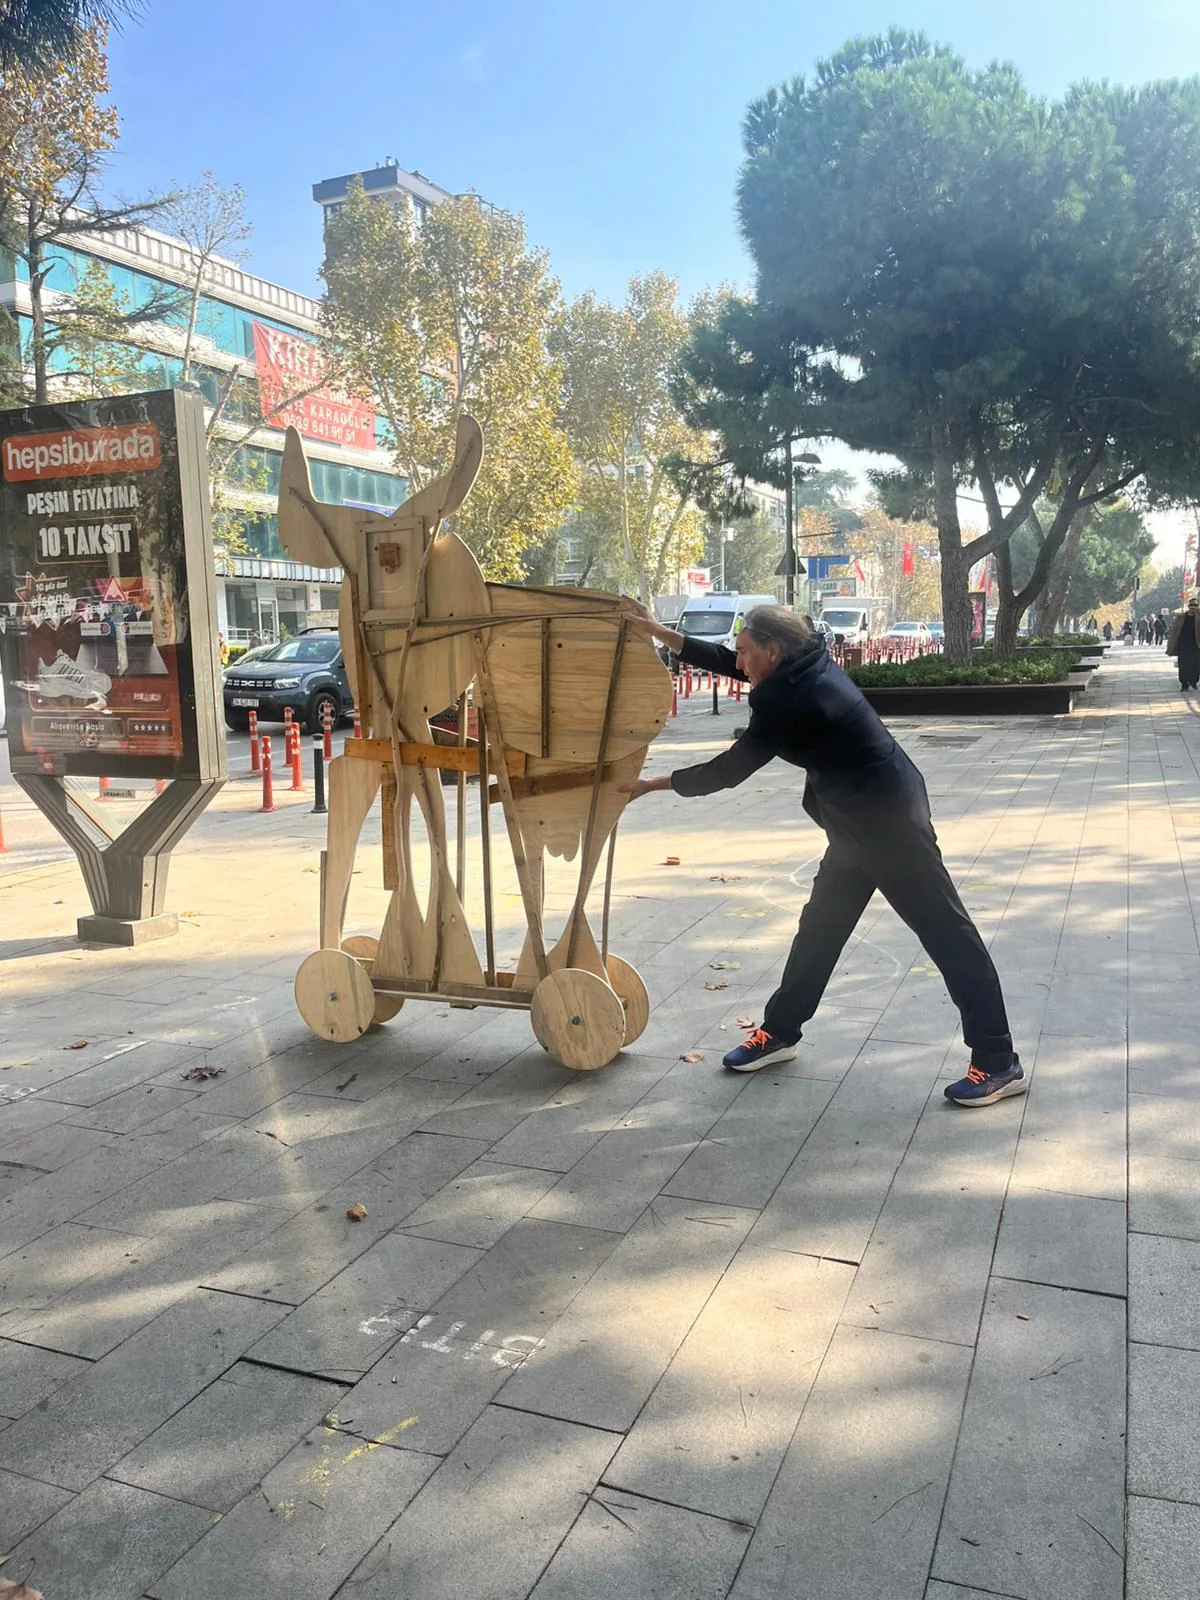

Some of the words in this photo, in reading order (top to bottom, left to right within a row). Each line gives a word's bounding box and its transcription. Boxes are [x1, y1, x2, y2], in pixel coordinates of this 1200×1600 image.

[7, 428, 155, 474] hepsiburada
[27, 490, 70, 517] PEŞİN
[73, 485, 140, 512] FİYATINA
[39, 526, 62, 557] 10
[64, 523, 132, 556] TAKSİT
